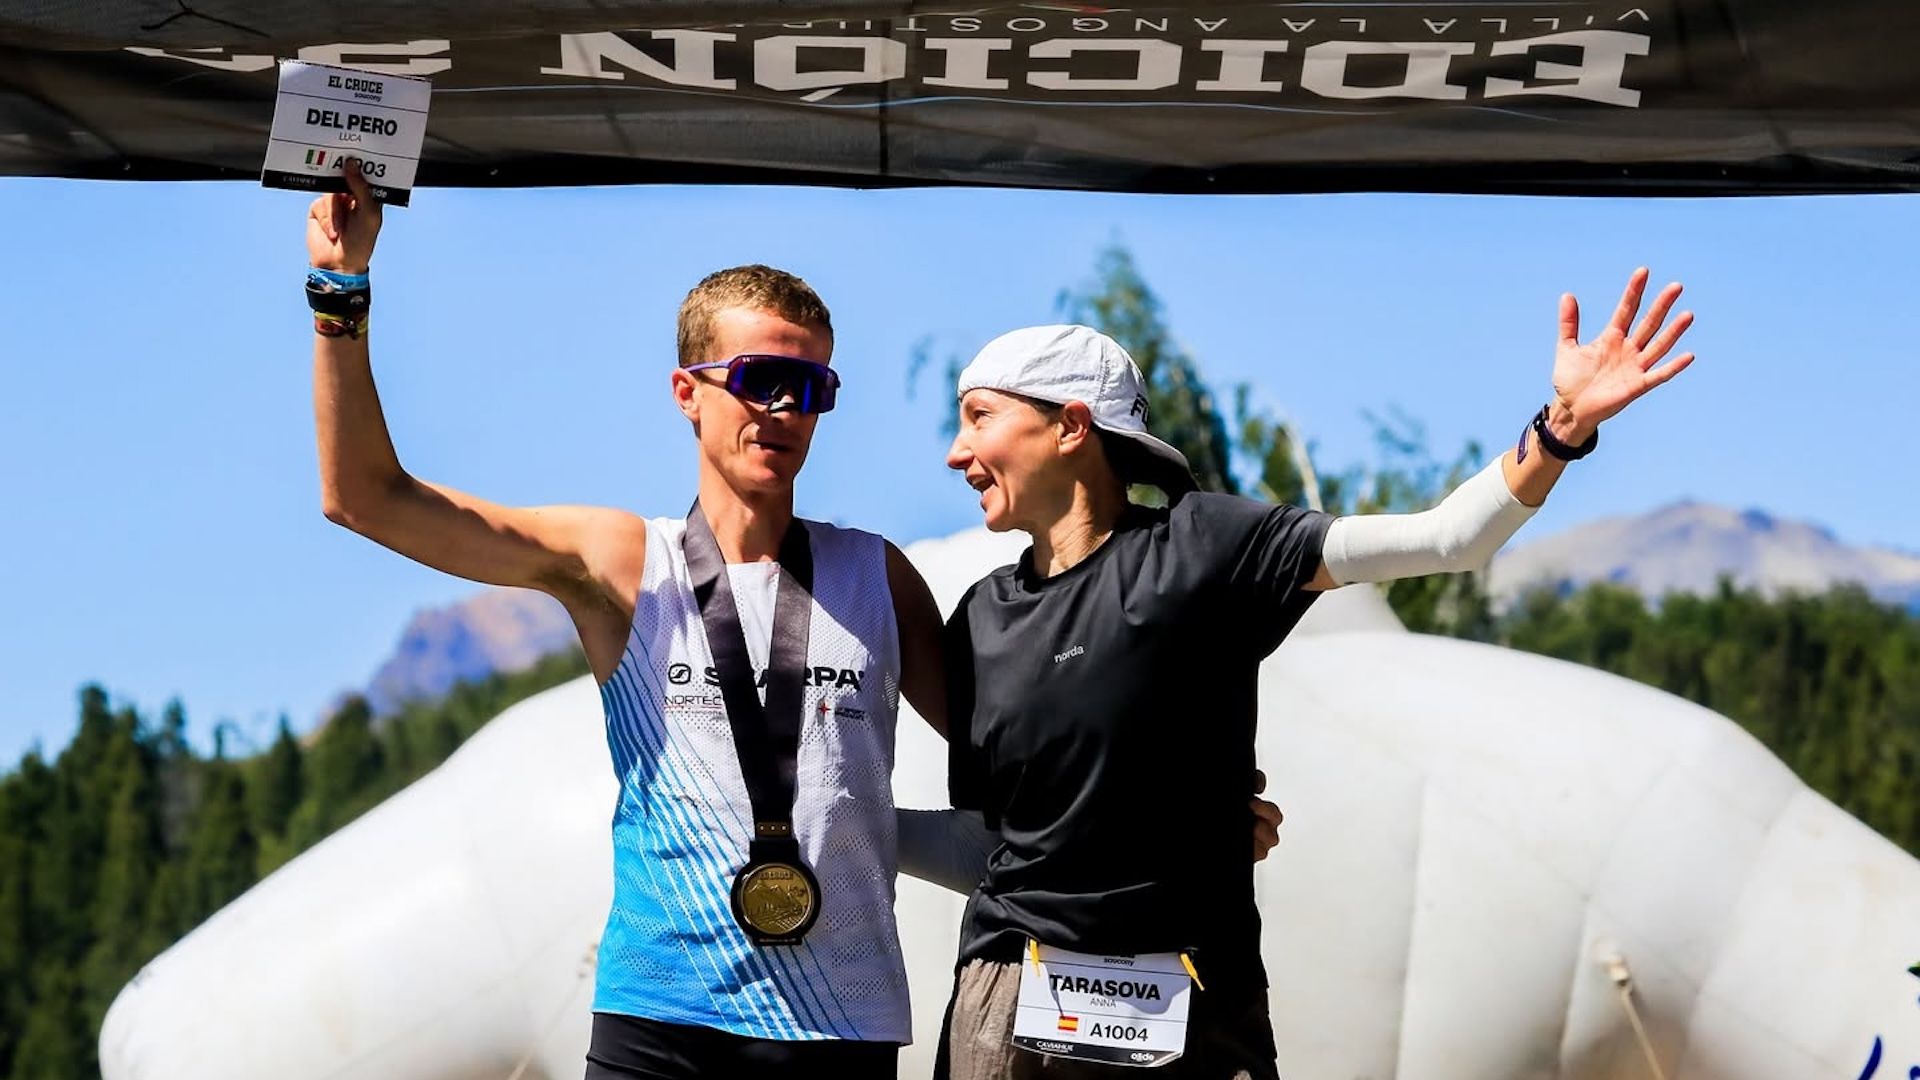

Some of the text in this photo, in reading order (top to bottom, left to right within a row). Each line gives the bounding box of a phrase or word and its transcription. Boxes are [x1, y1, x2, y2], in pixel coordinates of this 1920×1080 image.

[1282, 18, 1366, 33] LA
[1424, 8, 1650, 33] VILLA
[541, 29, 1650, 108] EDICIÓN
[328, 75, 383, 94] EL CRUCE
[306, 108, 397, 136] DEL PERO
[338, 133, 361, 142] LUCA
[332, 156, 386, 178] A03
[1054, 645, 1084, 663] norda
[1049, 974, 1161, 1000] TARASOVA
[1090, 998, 1116, 1009] ANNA
[1090, 1023, 1149, 1042] A1004
